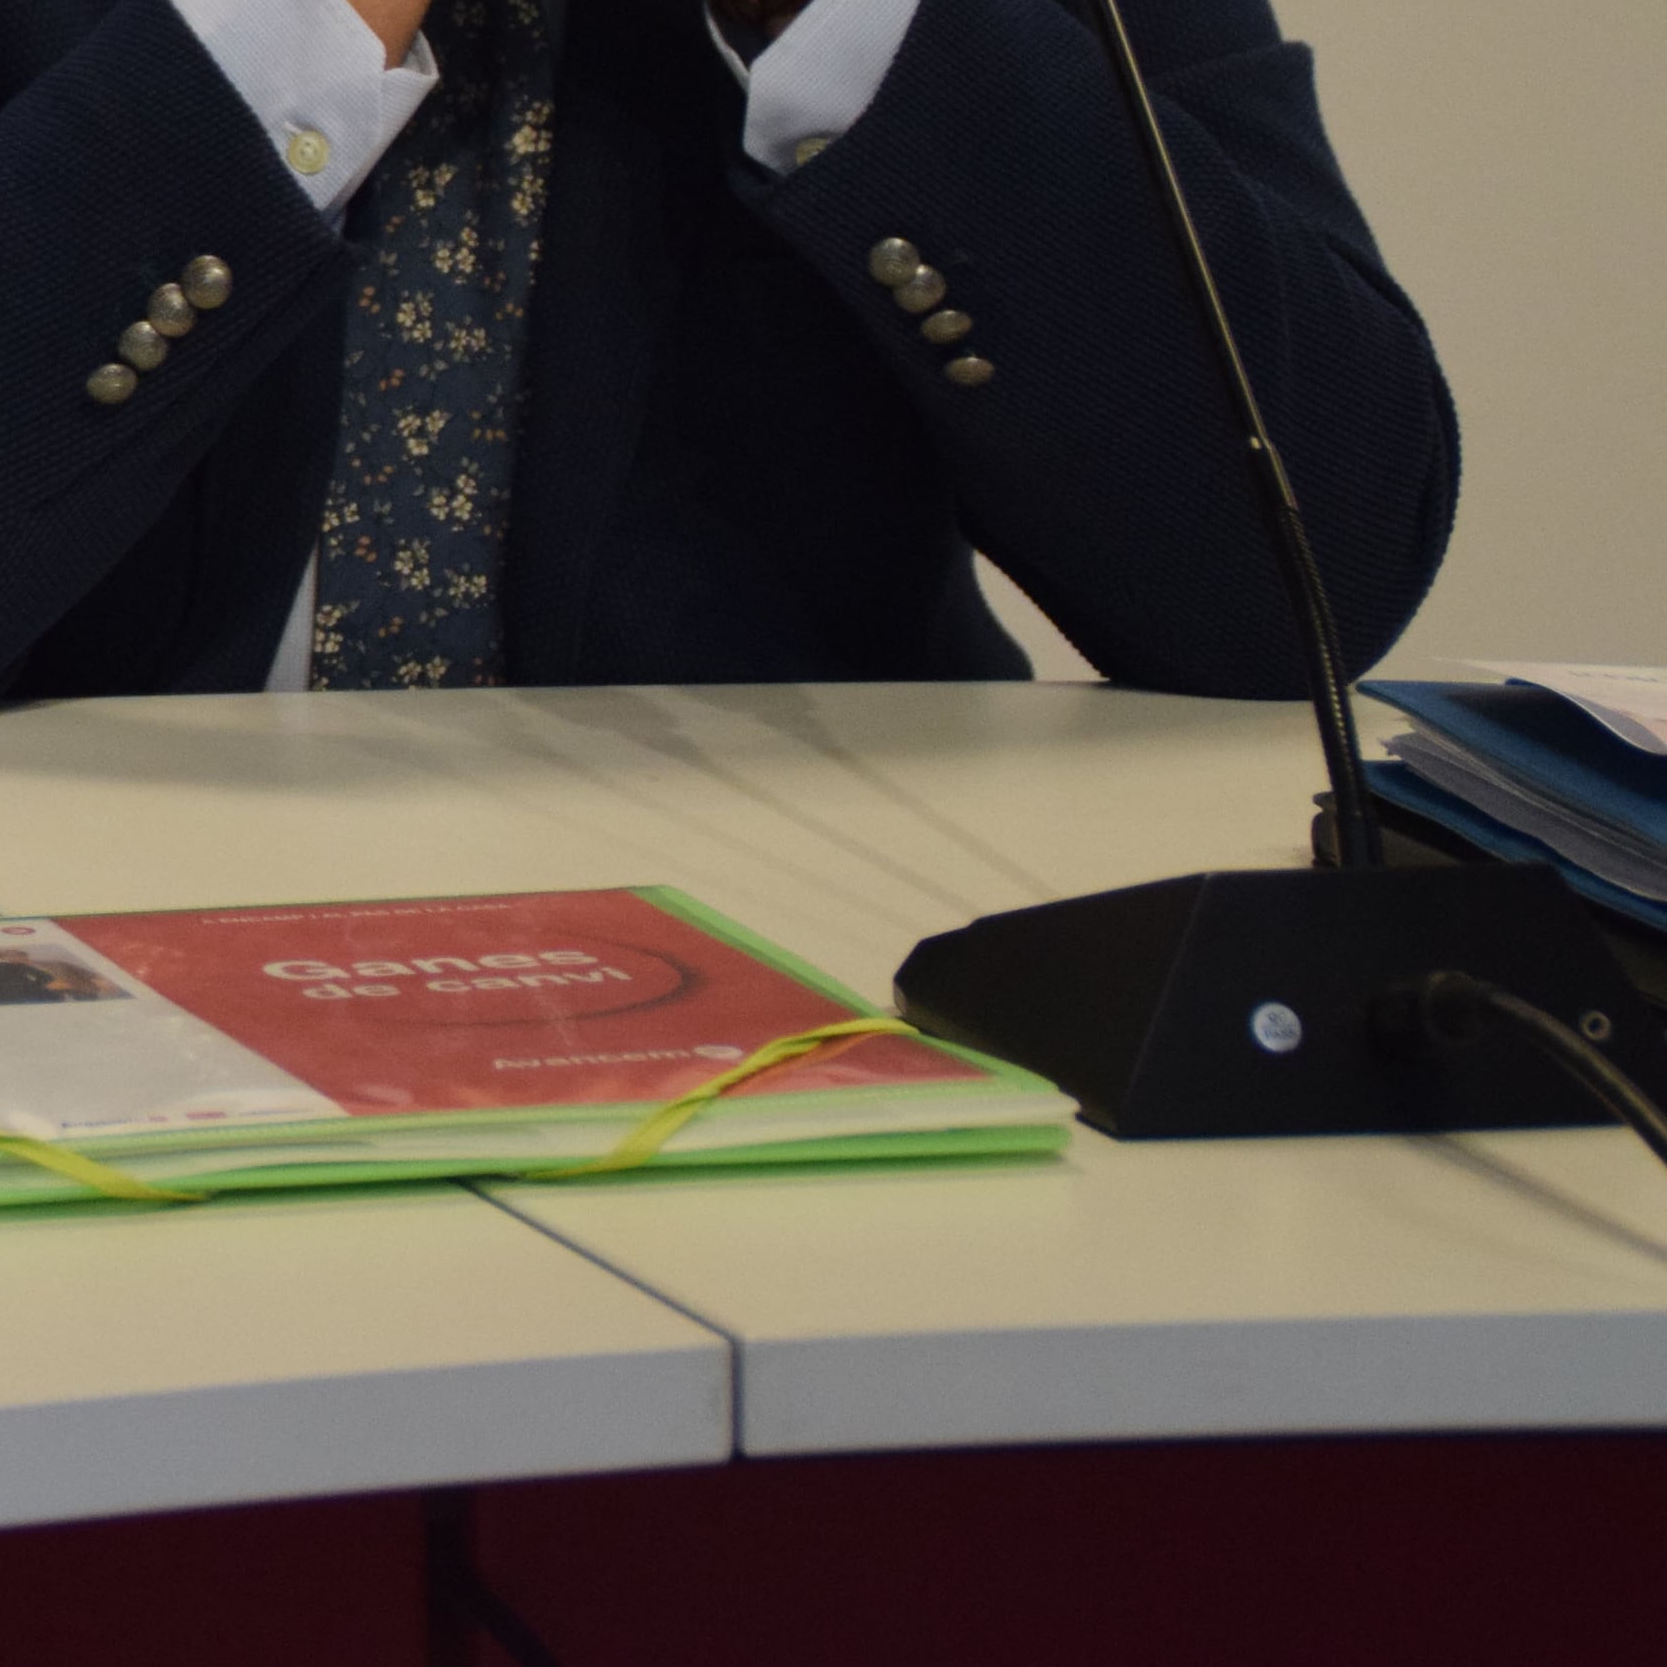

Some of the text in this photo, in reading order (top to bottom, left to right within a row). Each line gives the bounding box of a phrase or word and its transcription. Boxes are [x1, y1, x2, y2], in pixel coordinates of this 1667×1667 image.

[261, 950, 599, 981] Ganes
[302, 966, 633, 999] de canvi
[492, 1049, 692, 1071] Avancem
